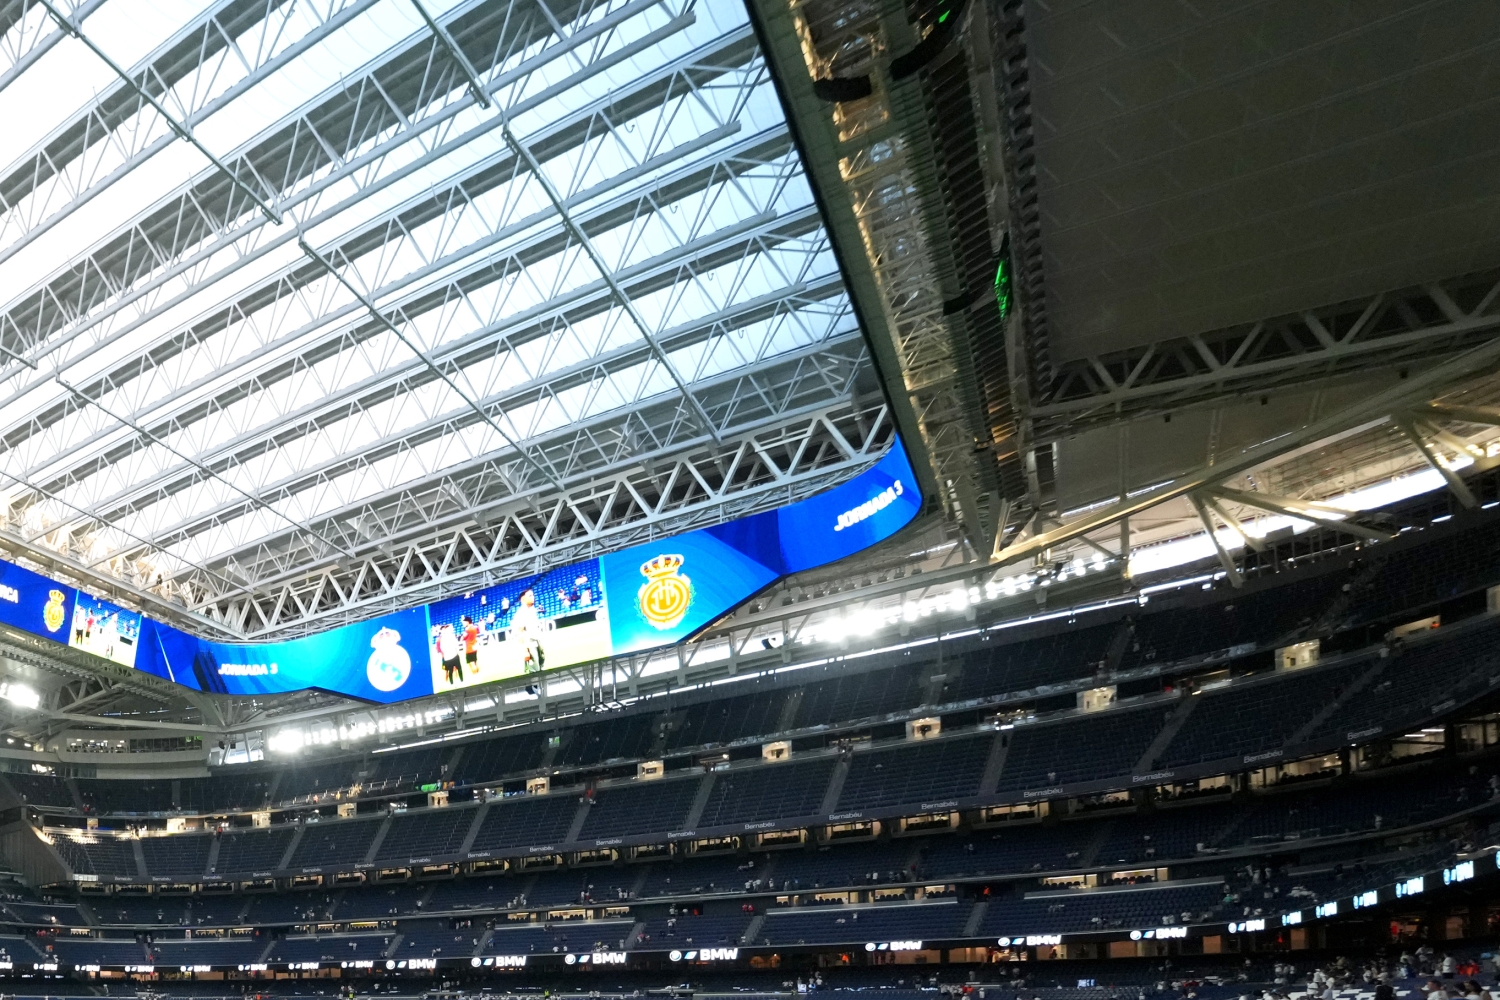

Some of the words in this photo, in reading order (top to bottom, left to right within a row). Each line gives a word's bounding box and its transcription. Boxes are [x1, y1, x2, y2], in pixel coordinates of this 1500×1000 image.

[834, 486, 898, 532] JORNADA
[894, 479, 903, 496] 3
[218, 663, 269, 676] JORNADA
[270, 662, 279, 675] 3
[1023, 788, 1063, 798] Bernabéu
[921, 801, 958, 809] Bernabéu
[829, 812, 862, 820] Bernabéu
[745, 821, 775, 830] Bernabéu
[1155, 927, 1187, 939] BMW
[1026, 935, 1061, 946] BMW
[889, 942, 922, 951] BMW
[592, 952, 626, 964] BMW
[700, 948, 738, 961] BMW
[409, 959, 436, 970] BMW
[496, 956, 526, 966] BMW
